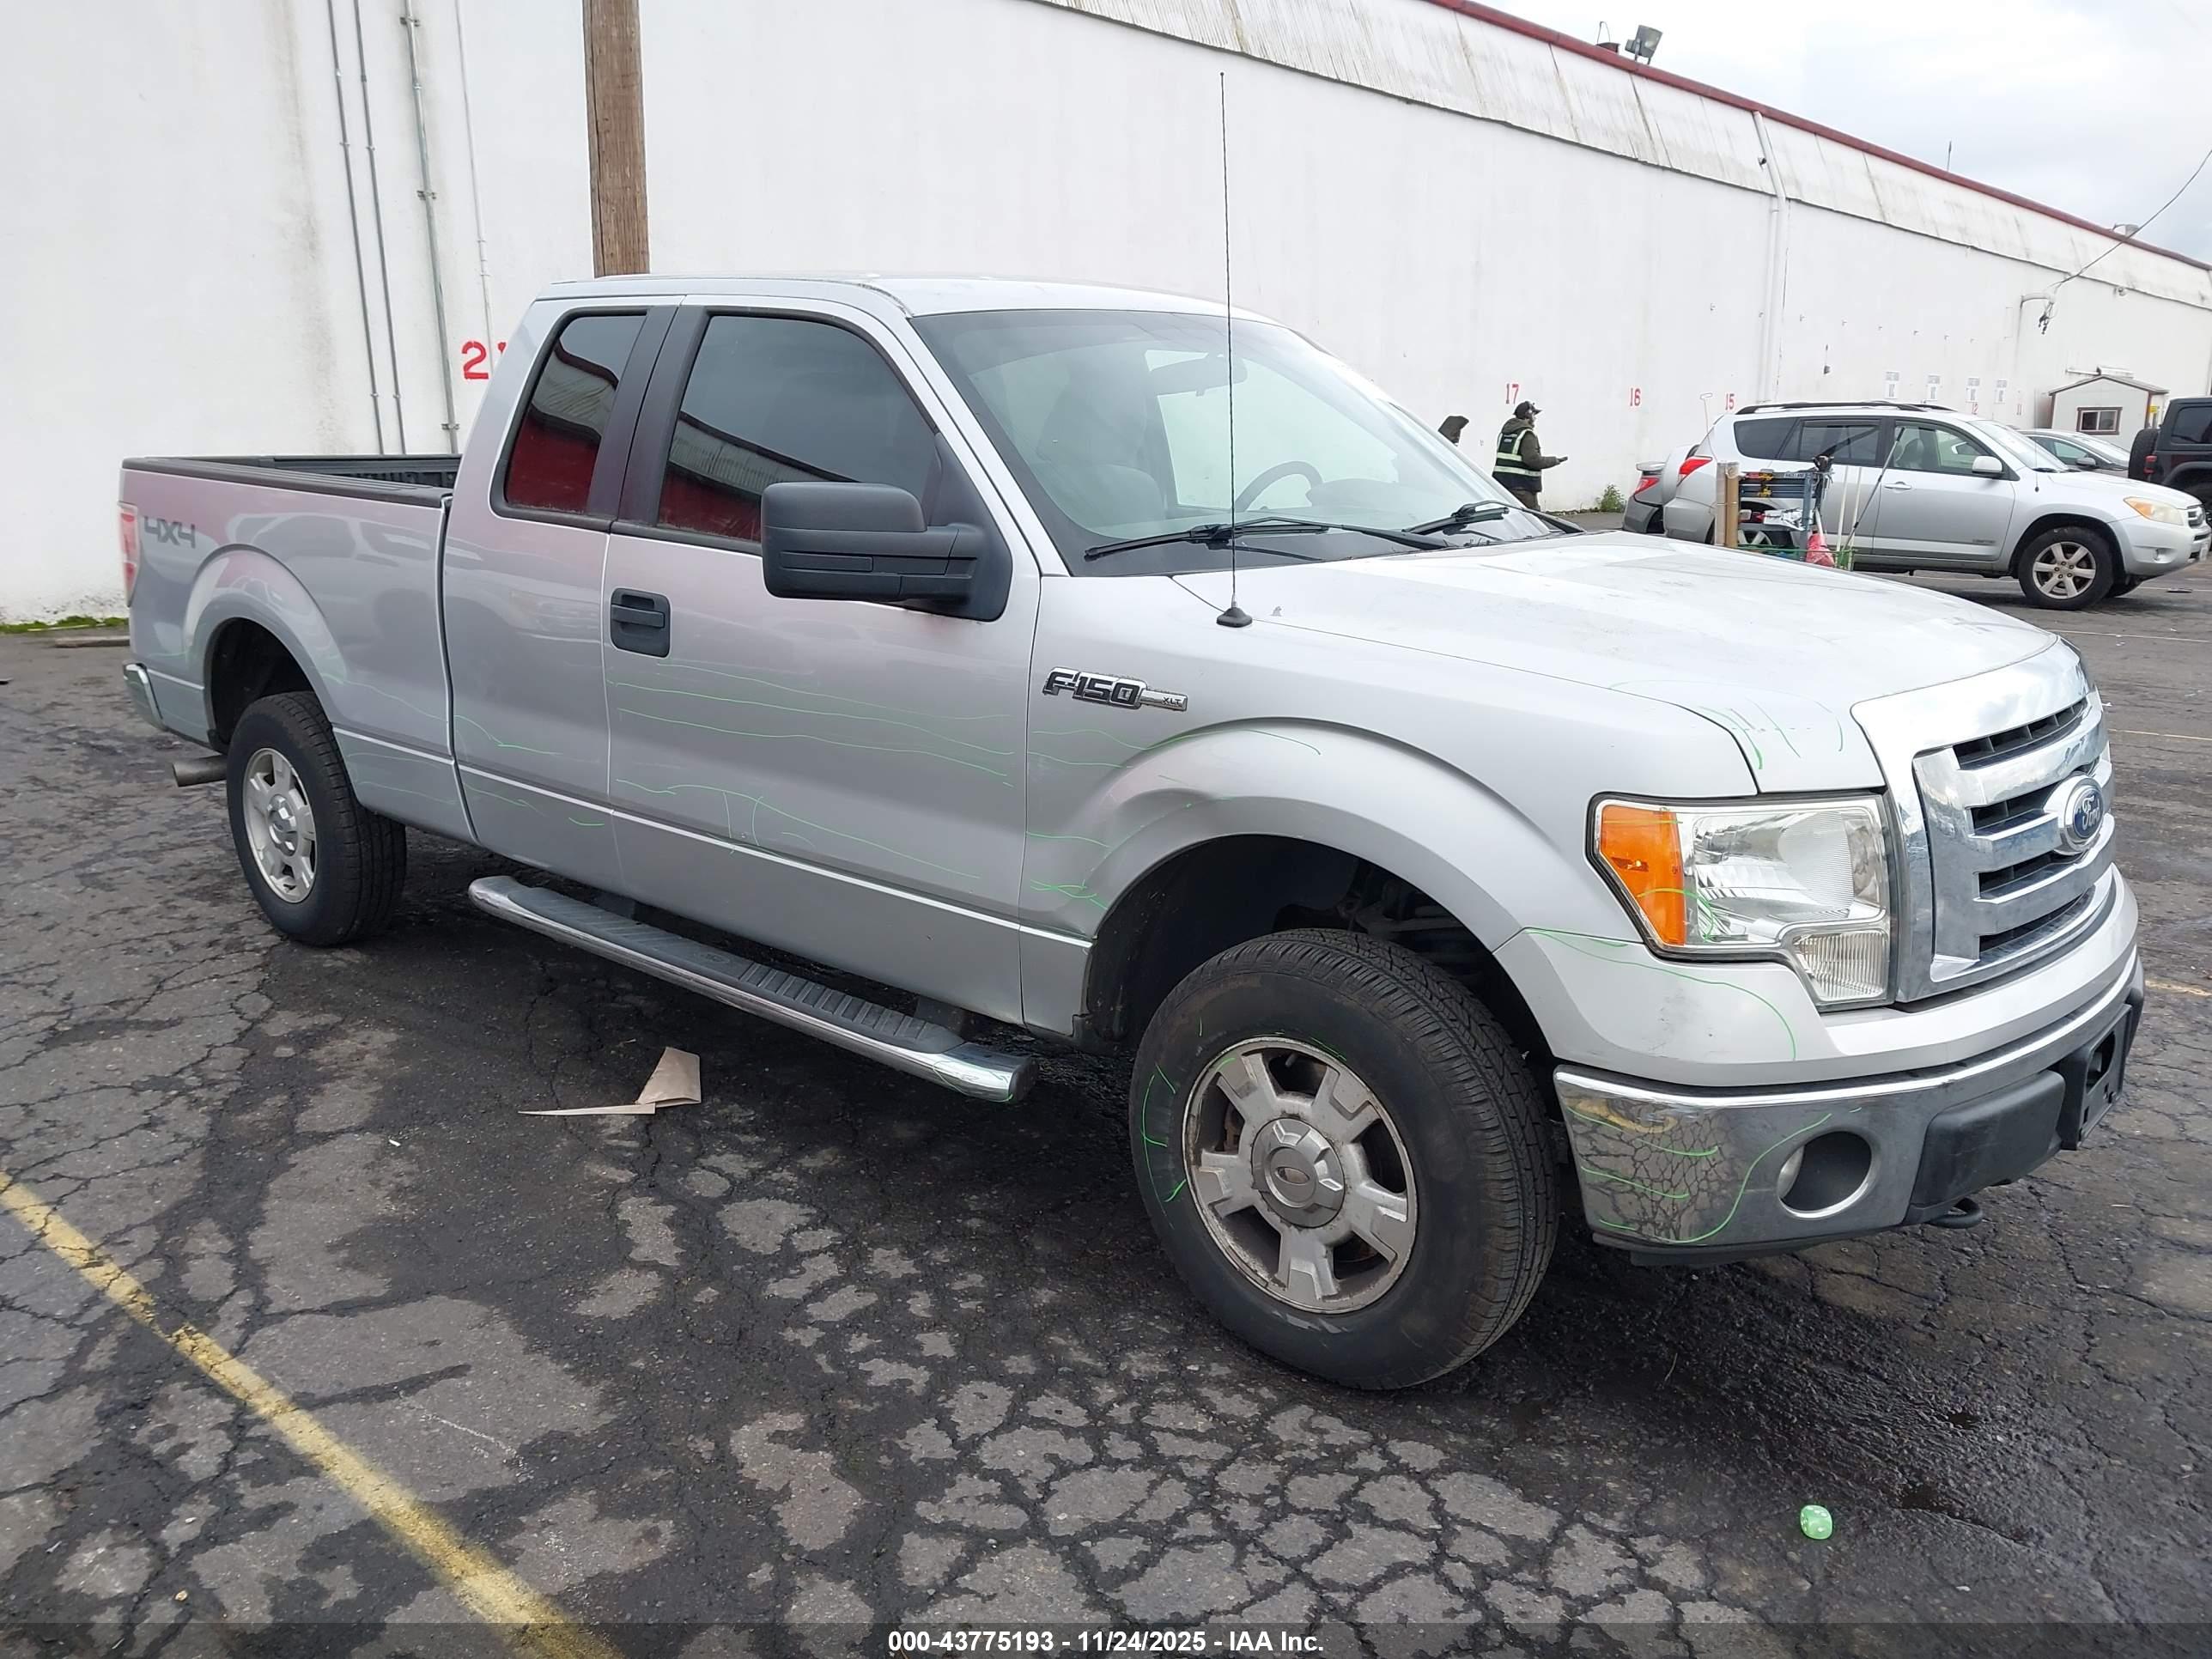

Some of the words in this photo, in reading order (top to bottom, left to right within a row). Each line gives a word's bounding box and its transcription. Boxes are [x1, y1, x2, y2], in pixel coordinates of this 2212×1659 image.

[461, 341, 507, 380] 2
[1505, 383, 1520, 404] 17
[1630, 387, 1641, 407] 16
[1725, 393, 1735, 410] 15
[1042, 666, 1147, 709] F-150
[1162, 696, 1182, 707] XLT
[2078, 794, 2101, 831] Ford
